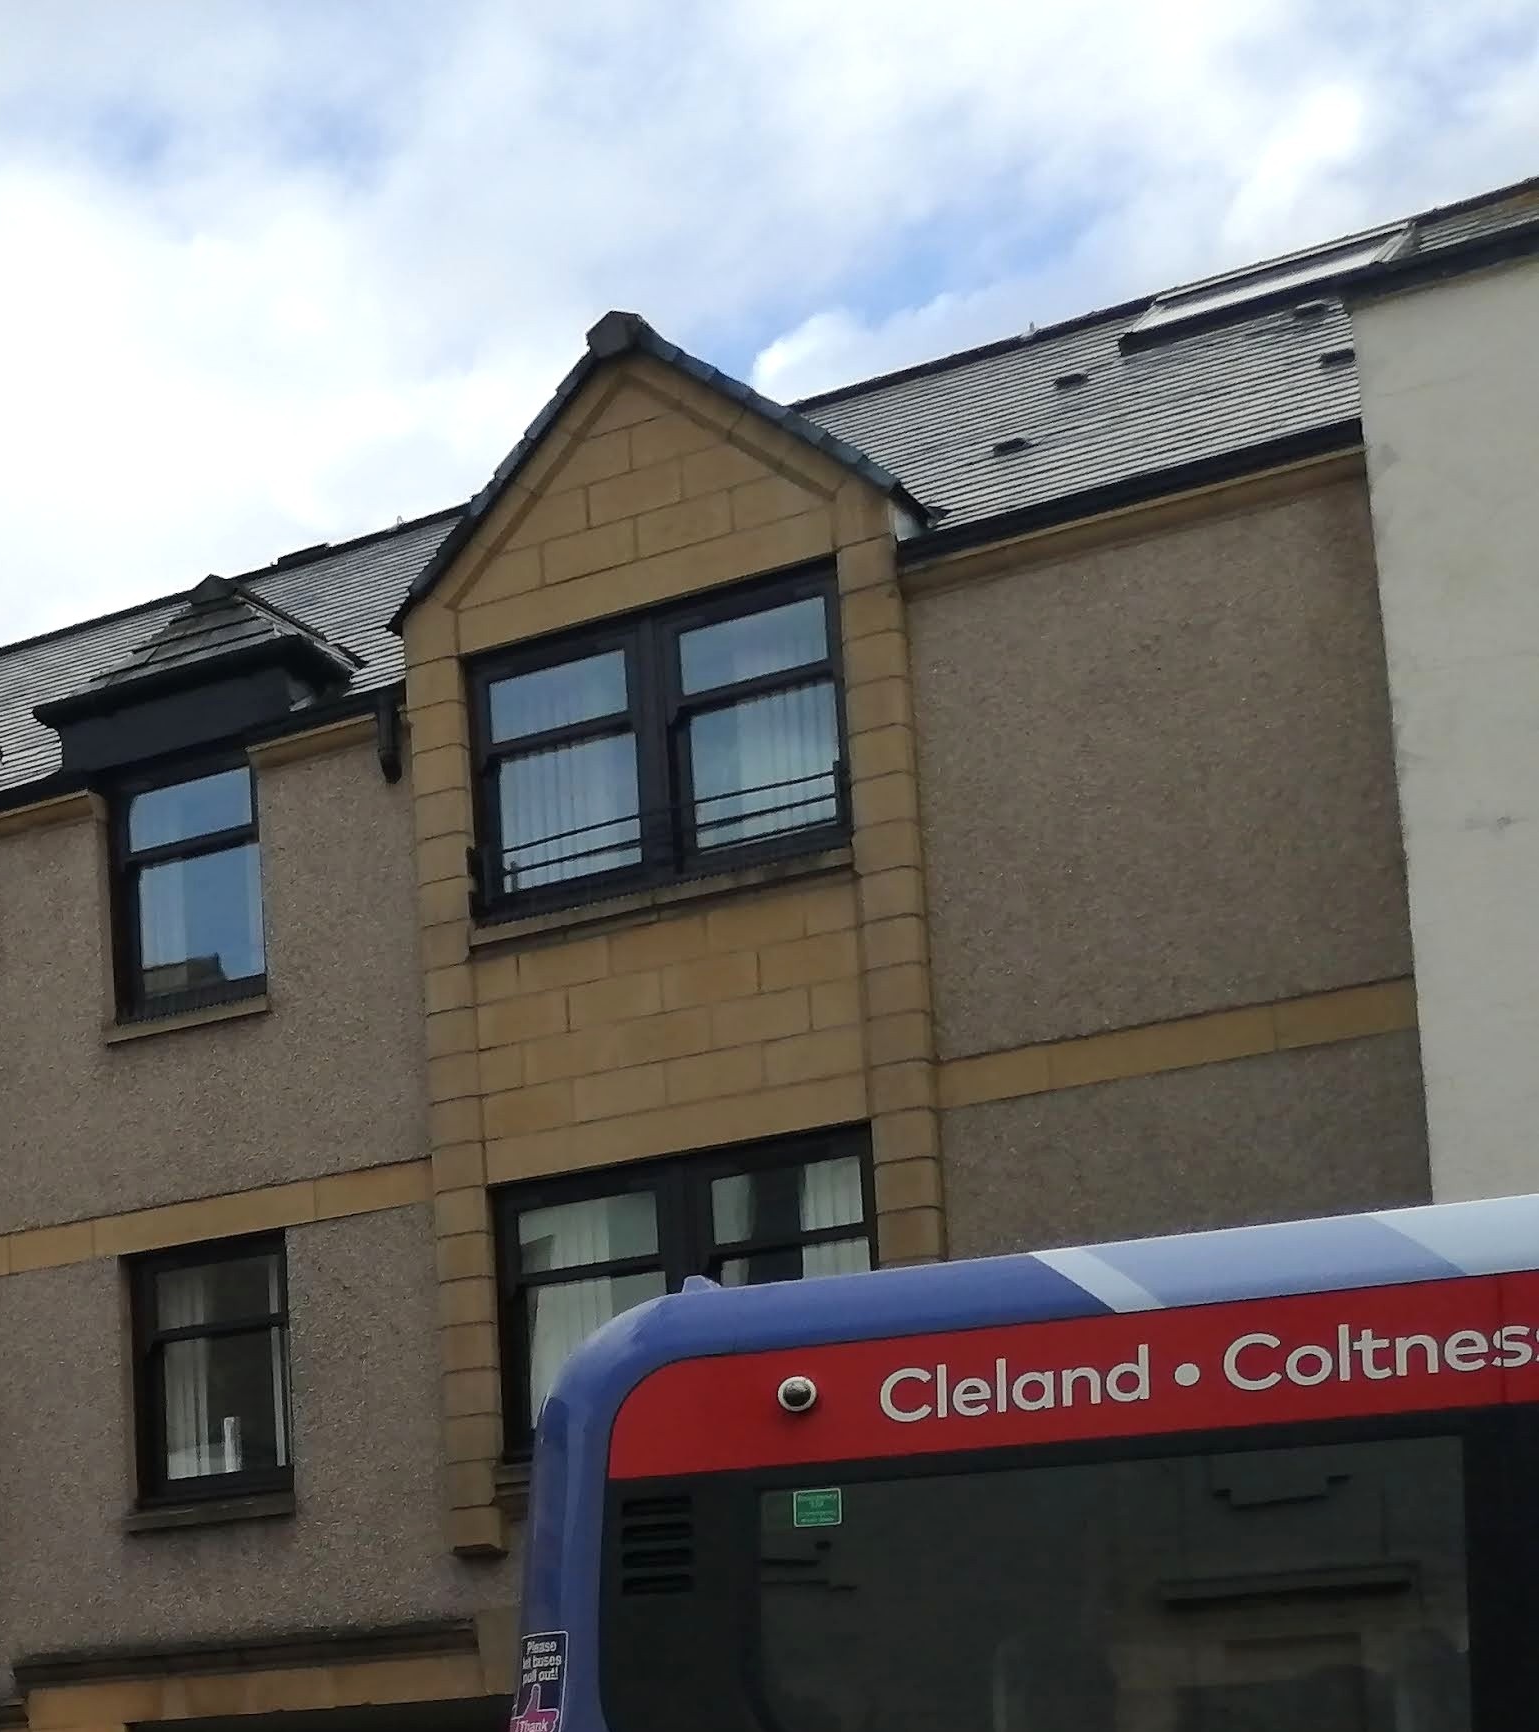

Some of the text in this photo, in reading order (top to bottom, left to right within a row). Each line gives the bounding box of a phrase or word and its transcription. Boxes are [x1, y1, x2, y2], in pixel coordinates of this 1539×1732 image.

[879, 1322, 1539, 1423] Cleland Coltnes
[526, 1641, 557, 1655] Please
[533, 1655, 562, 1668] buses
